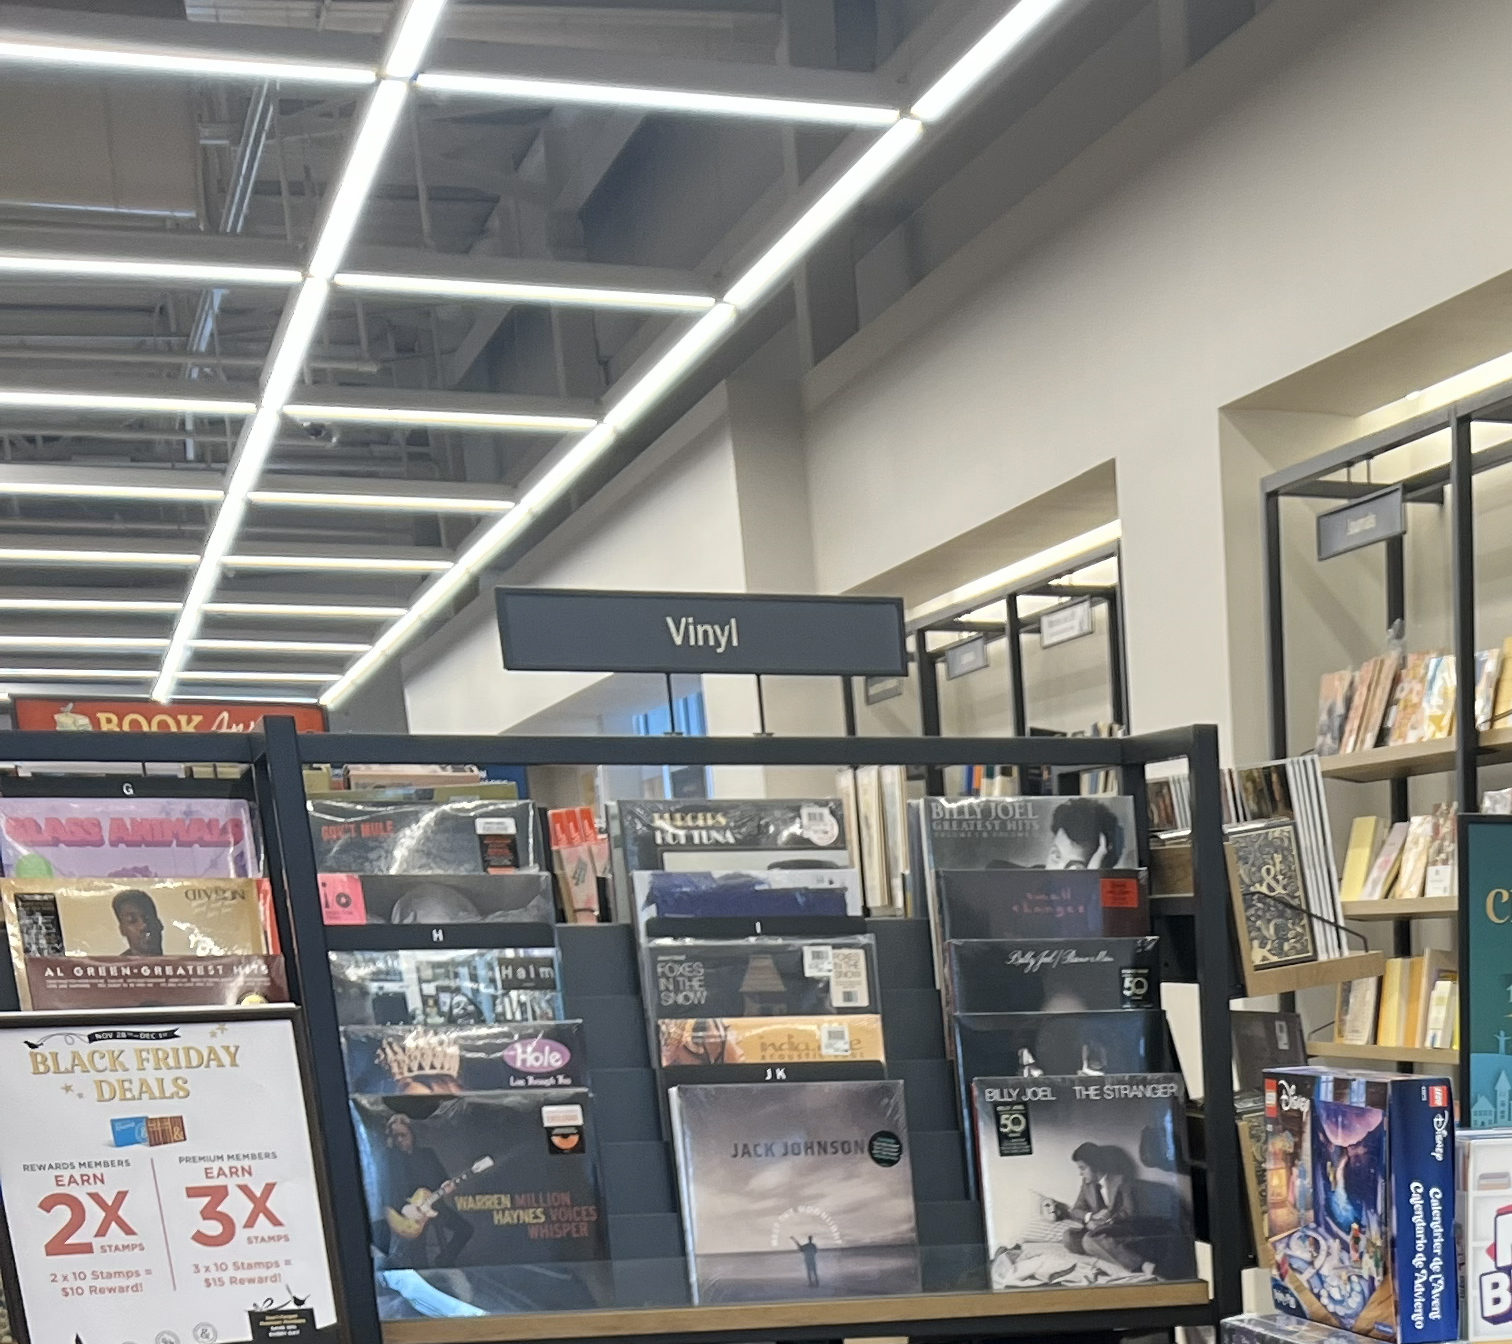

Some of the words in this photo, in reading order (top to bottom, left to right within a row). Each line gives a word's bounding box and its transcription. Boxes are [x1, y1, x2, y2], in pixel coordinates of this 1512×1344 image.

[665, 616, 739, 653] Vinyl
[122, 783, 135, 796] G
[931, 803, 985, 820] BILLY
[988, 802, 1039, 820] JOEL
[109, 817, 244, 847] ANIMALS
[932, 820, 1001, 831] GREATEST
[1006, 820, 1040, 831] HITS
[432, 929, 444, 942] H
[45, 967, 64, 978] AL
[657, 962, 704, 977] FOXES
[659, 977, 674, 991] IN
[677, 976, 704, 991] THE
[1122, 977, 1149, 997] 50
[661, 991, 708, 1006] SNOW
[29, 1046, 129, 1075] BLACK
[134, 1045, 240, 1072] FRIDAY
[516, 1046, 563, 1068] Hole
[93, 1076, 190, 1102] DEALS
[984, 1088, 1019, 1101] BILLY
[1021, 1086, 1057, 1101] JOEL
[1072, 1085, 1101, 1100] THE
[1103, 1084, 1179, 1099] STRANGER
[1000, 1113, 1027, 1133] 50
[1430, 1110, 1449, 1161] Disney
[731, 1142, 776, 1159] JACK
[781, 1138, 866, 1158] JOHNSON
[23, 1161, 76, 1172] REWARDS
[78, 1159, 131, 1170] MEMBERS
[179, 1153, 224, 1164] PREMIUM
[226, 1151, 278, 1162] MEMBERS
[54, 1174, 106, 1187] EARN
[204, 1166, 253, 1180] EARN
[454, 1193, 512, 1211] WARREN
[37, 1190, 138, 1257] 2X
[184, 1182, 285, 1248] 3X
[493, 1207, 546, 1225] HAYNES
[551, 1206, 598, 1223] VOICES
[1409, 1181, 1427, 1251] Calendario
[1428, 1187, 1444, 1255] Calendrier
[246, 1234, 290, 1244] STAMPS
[528, 1222, 589, 1239] WHISPER
[100, 1243, 146, 1254] STAMPS
[214, 1262, 229, 1272] 10
[232, 1258, 281, 1274] Stamps
[72, 1271, 87, 1282] 10
[92, 1268, 141, 1283] Stamps
[203, 1276, 226, 1287] $15
[230, 1273, 282, 1286] Reward!
[60, 1286, 85, 1297] $10
[88, 1283, 144, 1296] Reward!
[1410, 1269, 1427, 1330] Adviento
